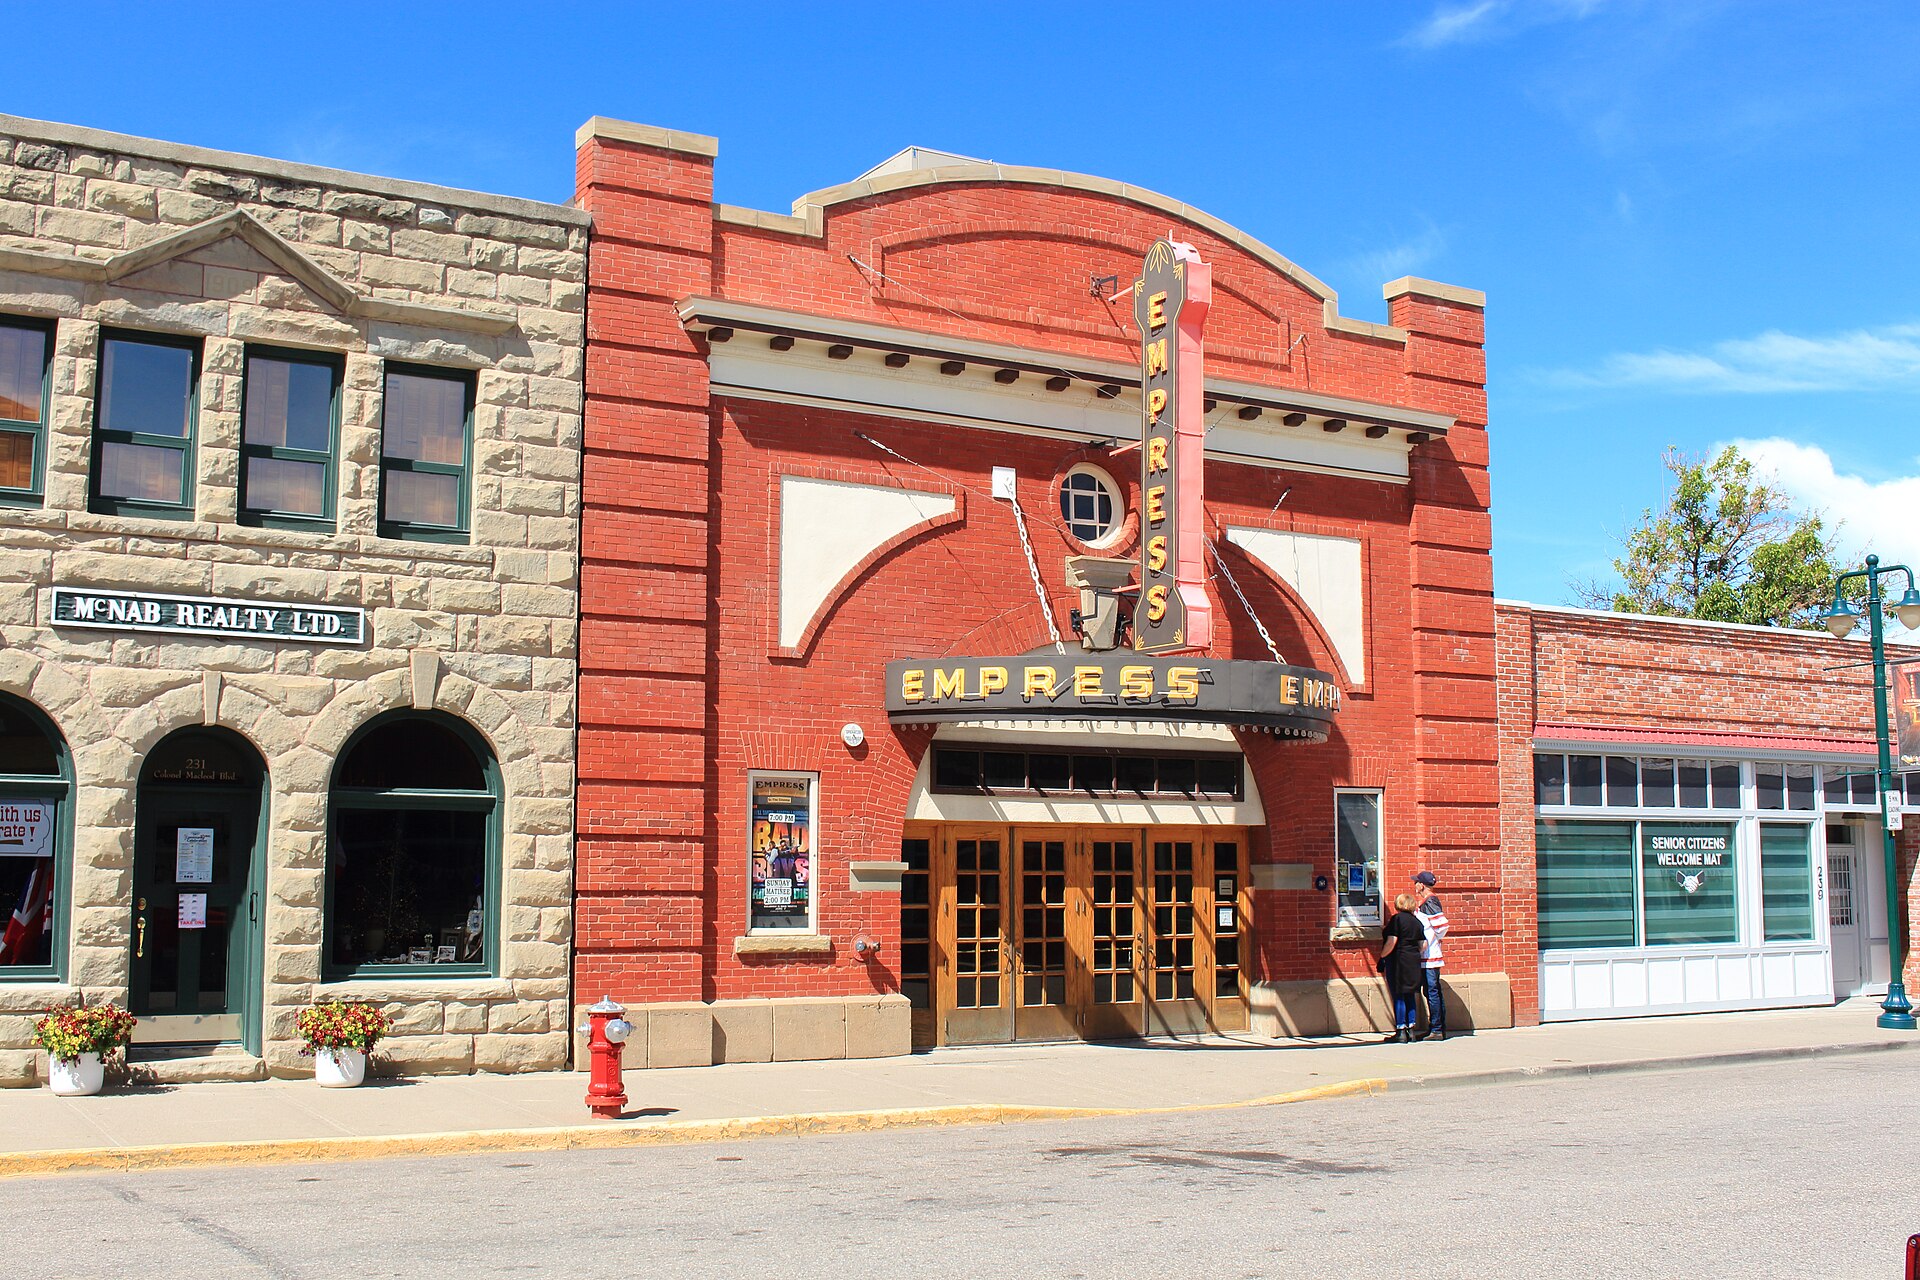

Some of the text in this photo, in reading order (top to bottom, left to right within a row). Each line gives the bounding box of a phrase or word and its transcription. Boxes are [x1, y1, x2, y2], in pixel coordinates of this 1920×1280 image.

[1146, 290, 1168, 622] EMPRESS
[176, 603, 279, 632] REALTY
[292, 611, 346, 635] LTD.
[902, 665, 1204, 701] EMPRESS
[185, 758, 206, 769] 231
[153, 769, 182, 779] Colonel
[755, 780, 805, 791] EMPRESS
[0, 806, 41, 822] ith us
[753, 819, 809, 853] BAD
[1651, 836, 1726, 850] SENIOR CITIZENS
[1656, 852, 1722, 866] WELCOME MAT
[766, 879, 791, 887] SUNDAY
[793, 887, 809, 899] DIE
